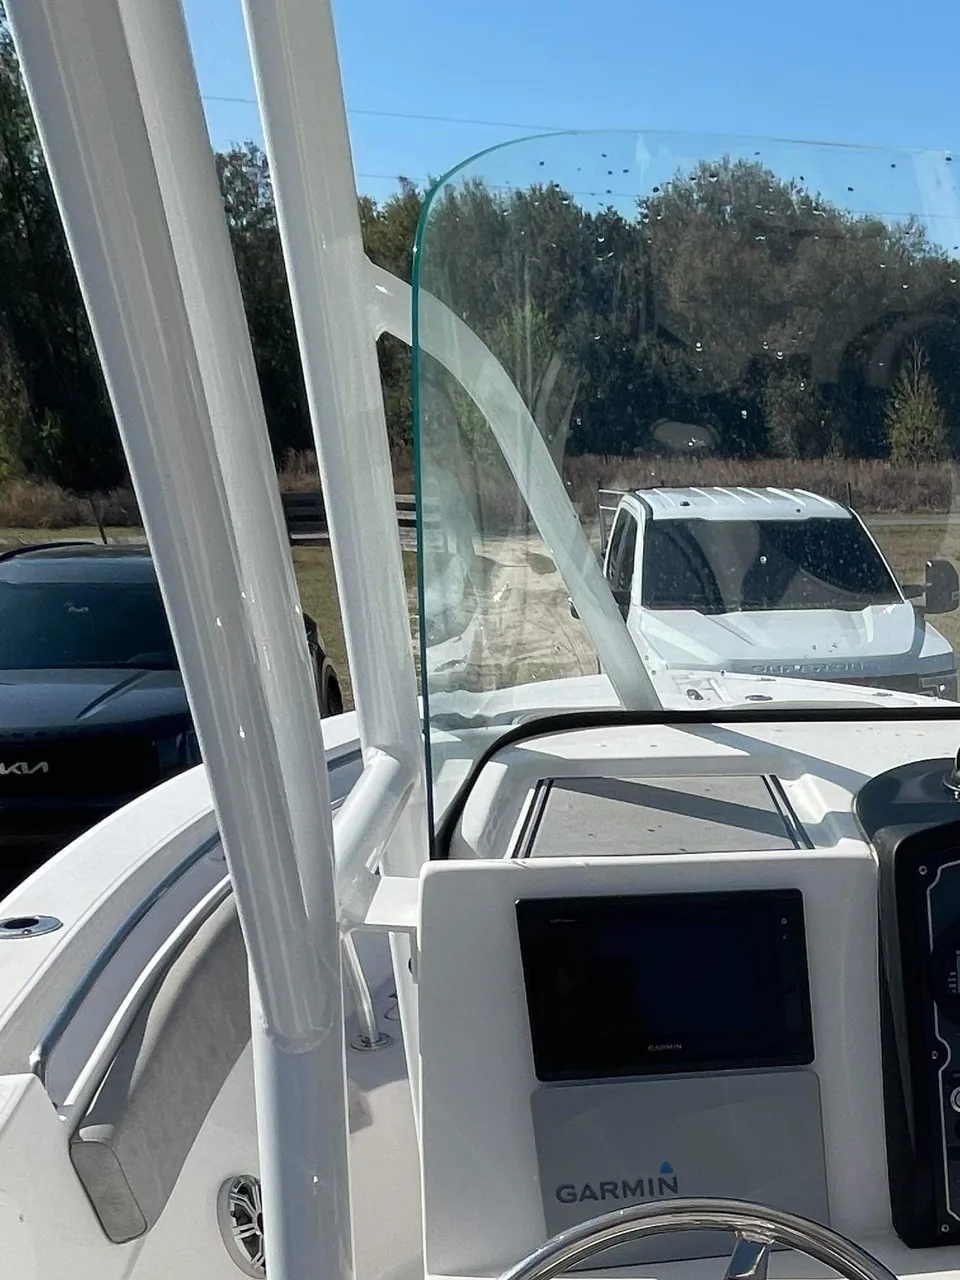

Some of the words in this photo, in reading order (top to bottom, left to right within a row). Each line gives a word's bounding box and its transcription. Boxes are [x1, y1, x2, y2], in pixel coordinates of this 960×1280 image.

[0, 761, 49, 775] KIA
[647, 1043, 683, 1051] GARMIN
[555, 1175, 679, 1205] GARMIN
